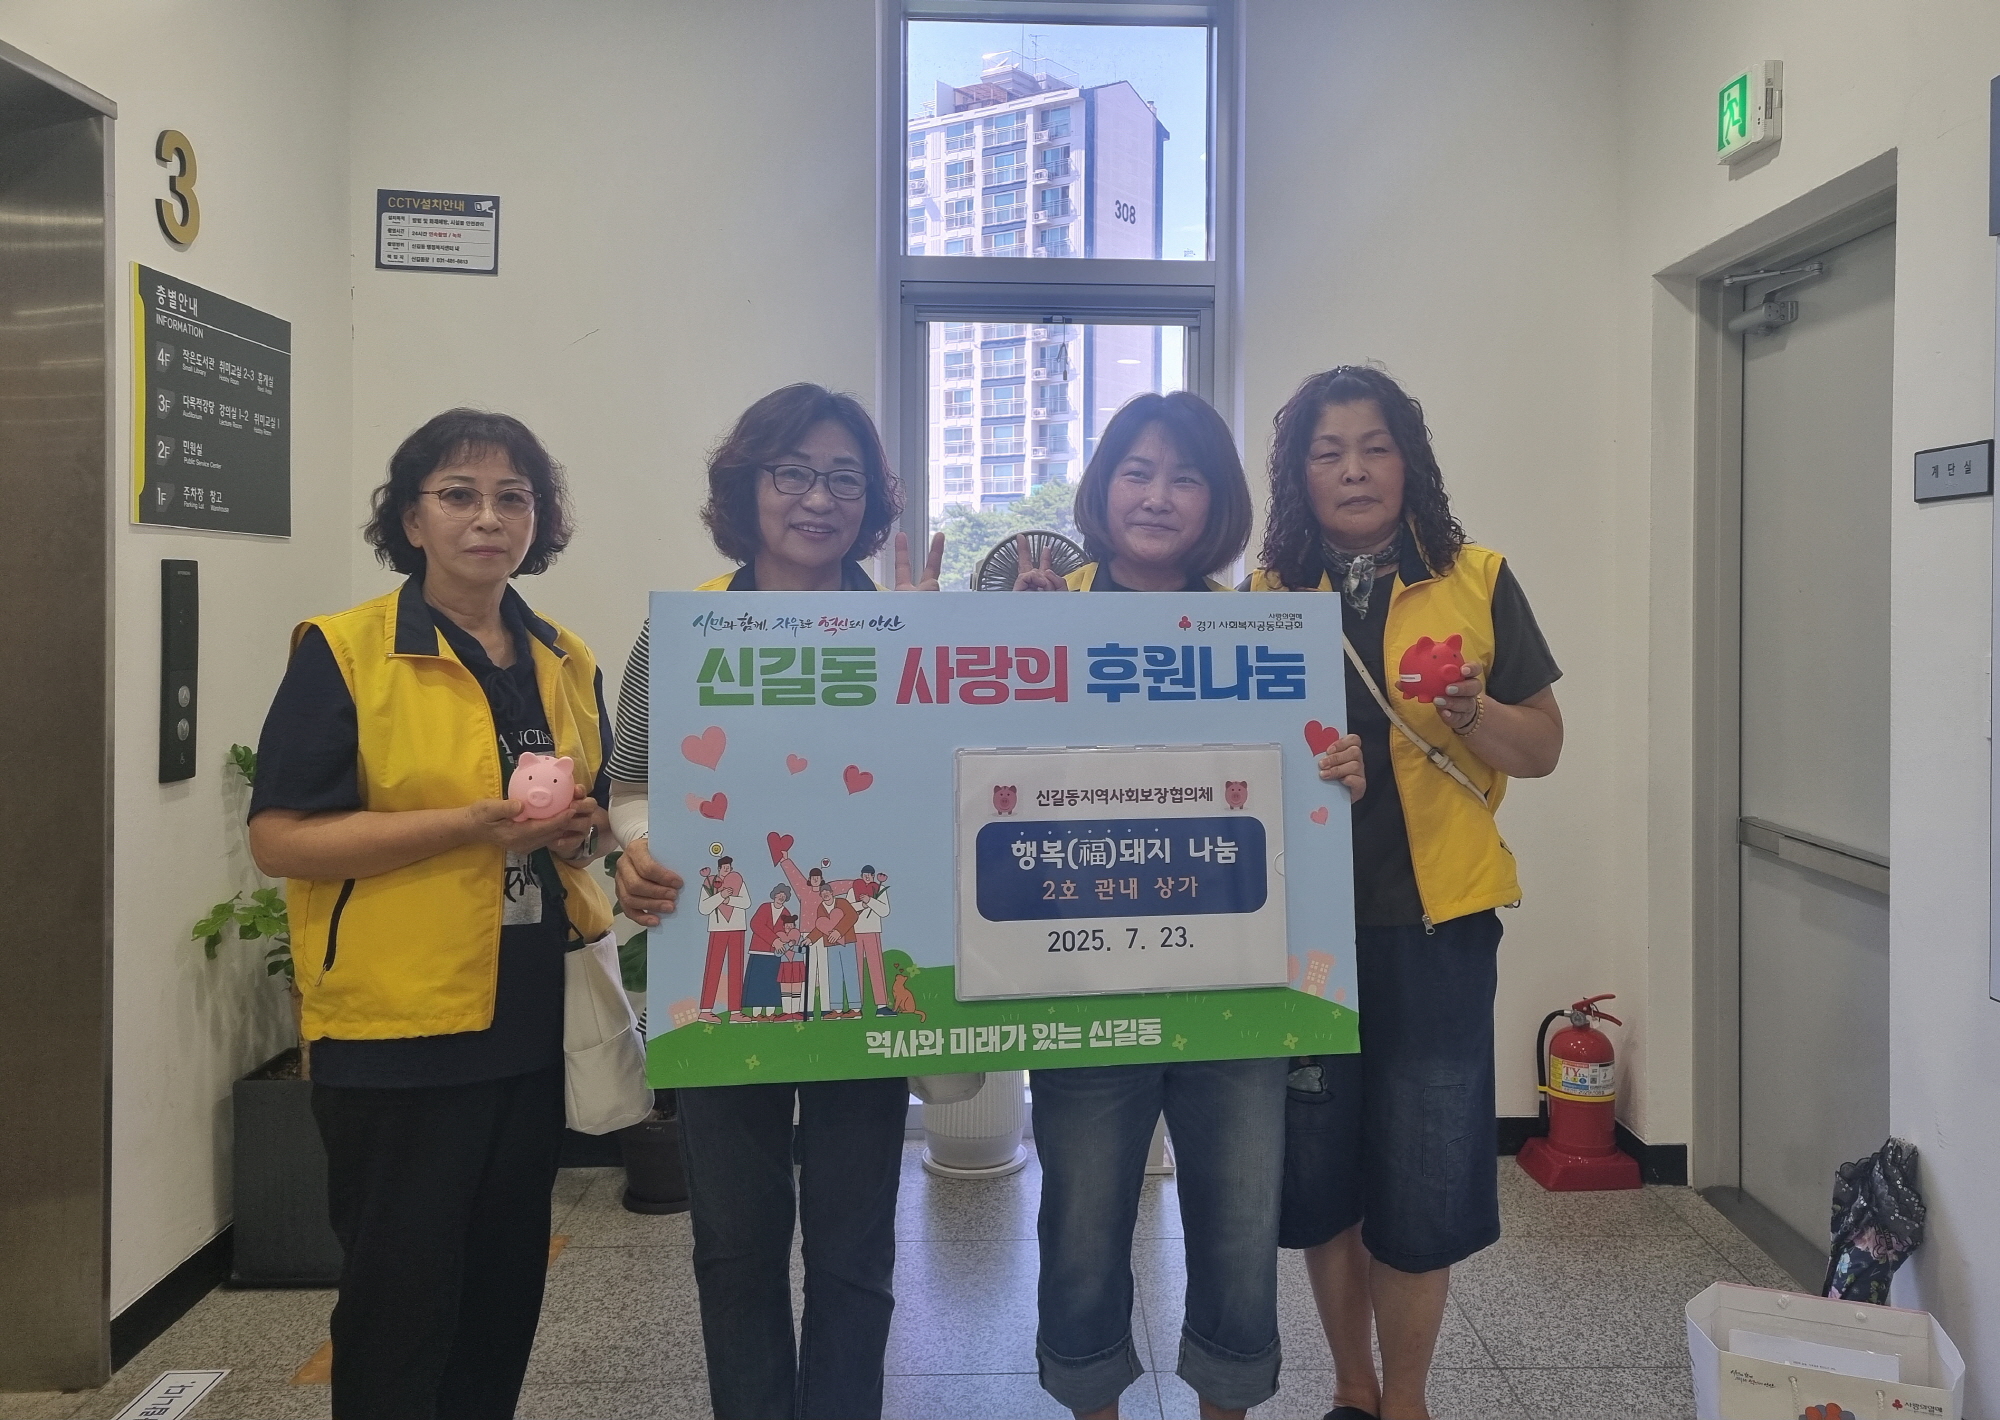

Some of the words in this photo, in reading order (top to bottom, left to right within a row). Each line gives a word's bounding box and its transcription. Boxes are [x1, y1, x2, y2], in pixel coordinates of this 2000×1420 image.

[155, 129, 200, 245] 3
[387, 196, 465, 212] CCTV설치안내
[1114, 199, 1136, 225] 308
[156, 284, 198, 318] 층별안내
[156, 313, 204, 339] INFORMATION
[157, 347, 171, 368] 4F
[182, 348, 215, 371] 작은도서관
[219, 359, 242, 379] 취미교실
[257, 372, 274, 389] 휴게실
[157, 393, 171, 414] 3F
[182, 394, 215, 415] 다목적강당
[219, 403, 237, 420] 강의실
[254, 413, 276, 430] 취미교실
[157, 440, 171, 459] 2F
[183, 440, 203, 457] 민원실
[1931, 460, 1972, 479] 계단실
[157, 487, 167, 506] 1F
[183, 486, 205, 502] 주차장
[209, 490, 223, 504] 창고
[692, 610, 737, 637] 시민과
[736, 611, 769, 632] 함께,
[771, 616, 814, 637] 자유로운
[817, 614, 864, 636] 혁신도시
[868, 614, 906, 632] 안산
[1196, 620, 1216, 632] 경기
[1218, 620, 1303, 632] 사회복지공동모금회
[696, 646, 878, 707] 신길동
[895, 645, 1069, 706] 사랑의
[1086, 643, 1307, 703] 후원나눔
[1036, 786, 1214, 808] 신길동지역사회보장협의체
[1011, 837, 1171, 871] 행복(福)돼지
[1188, 836, 1239, 865] 나눔
[1042, 879, 1079, 901] 2호
[1094, 877, 1138, 901] 관내
[1153, 876, 1199, 899] 상가
[1047, 929, 1112, 953] 2025.
[1125, 927, 1146, 950] 7.
[1159, 925, 1194, 949] 23.
[866, 1029, 945, 1058] 역사와
[949, 1024, 1027, 1055] 미래가
[1032, 1022, 1082, 1051] 있는
[1088, 1018, 1162, 1048] 신길동
